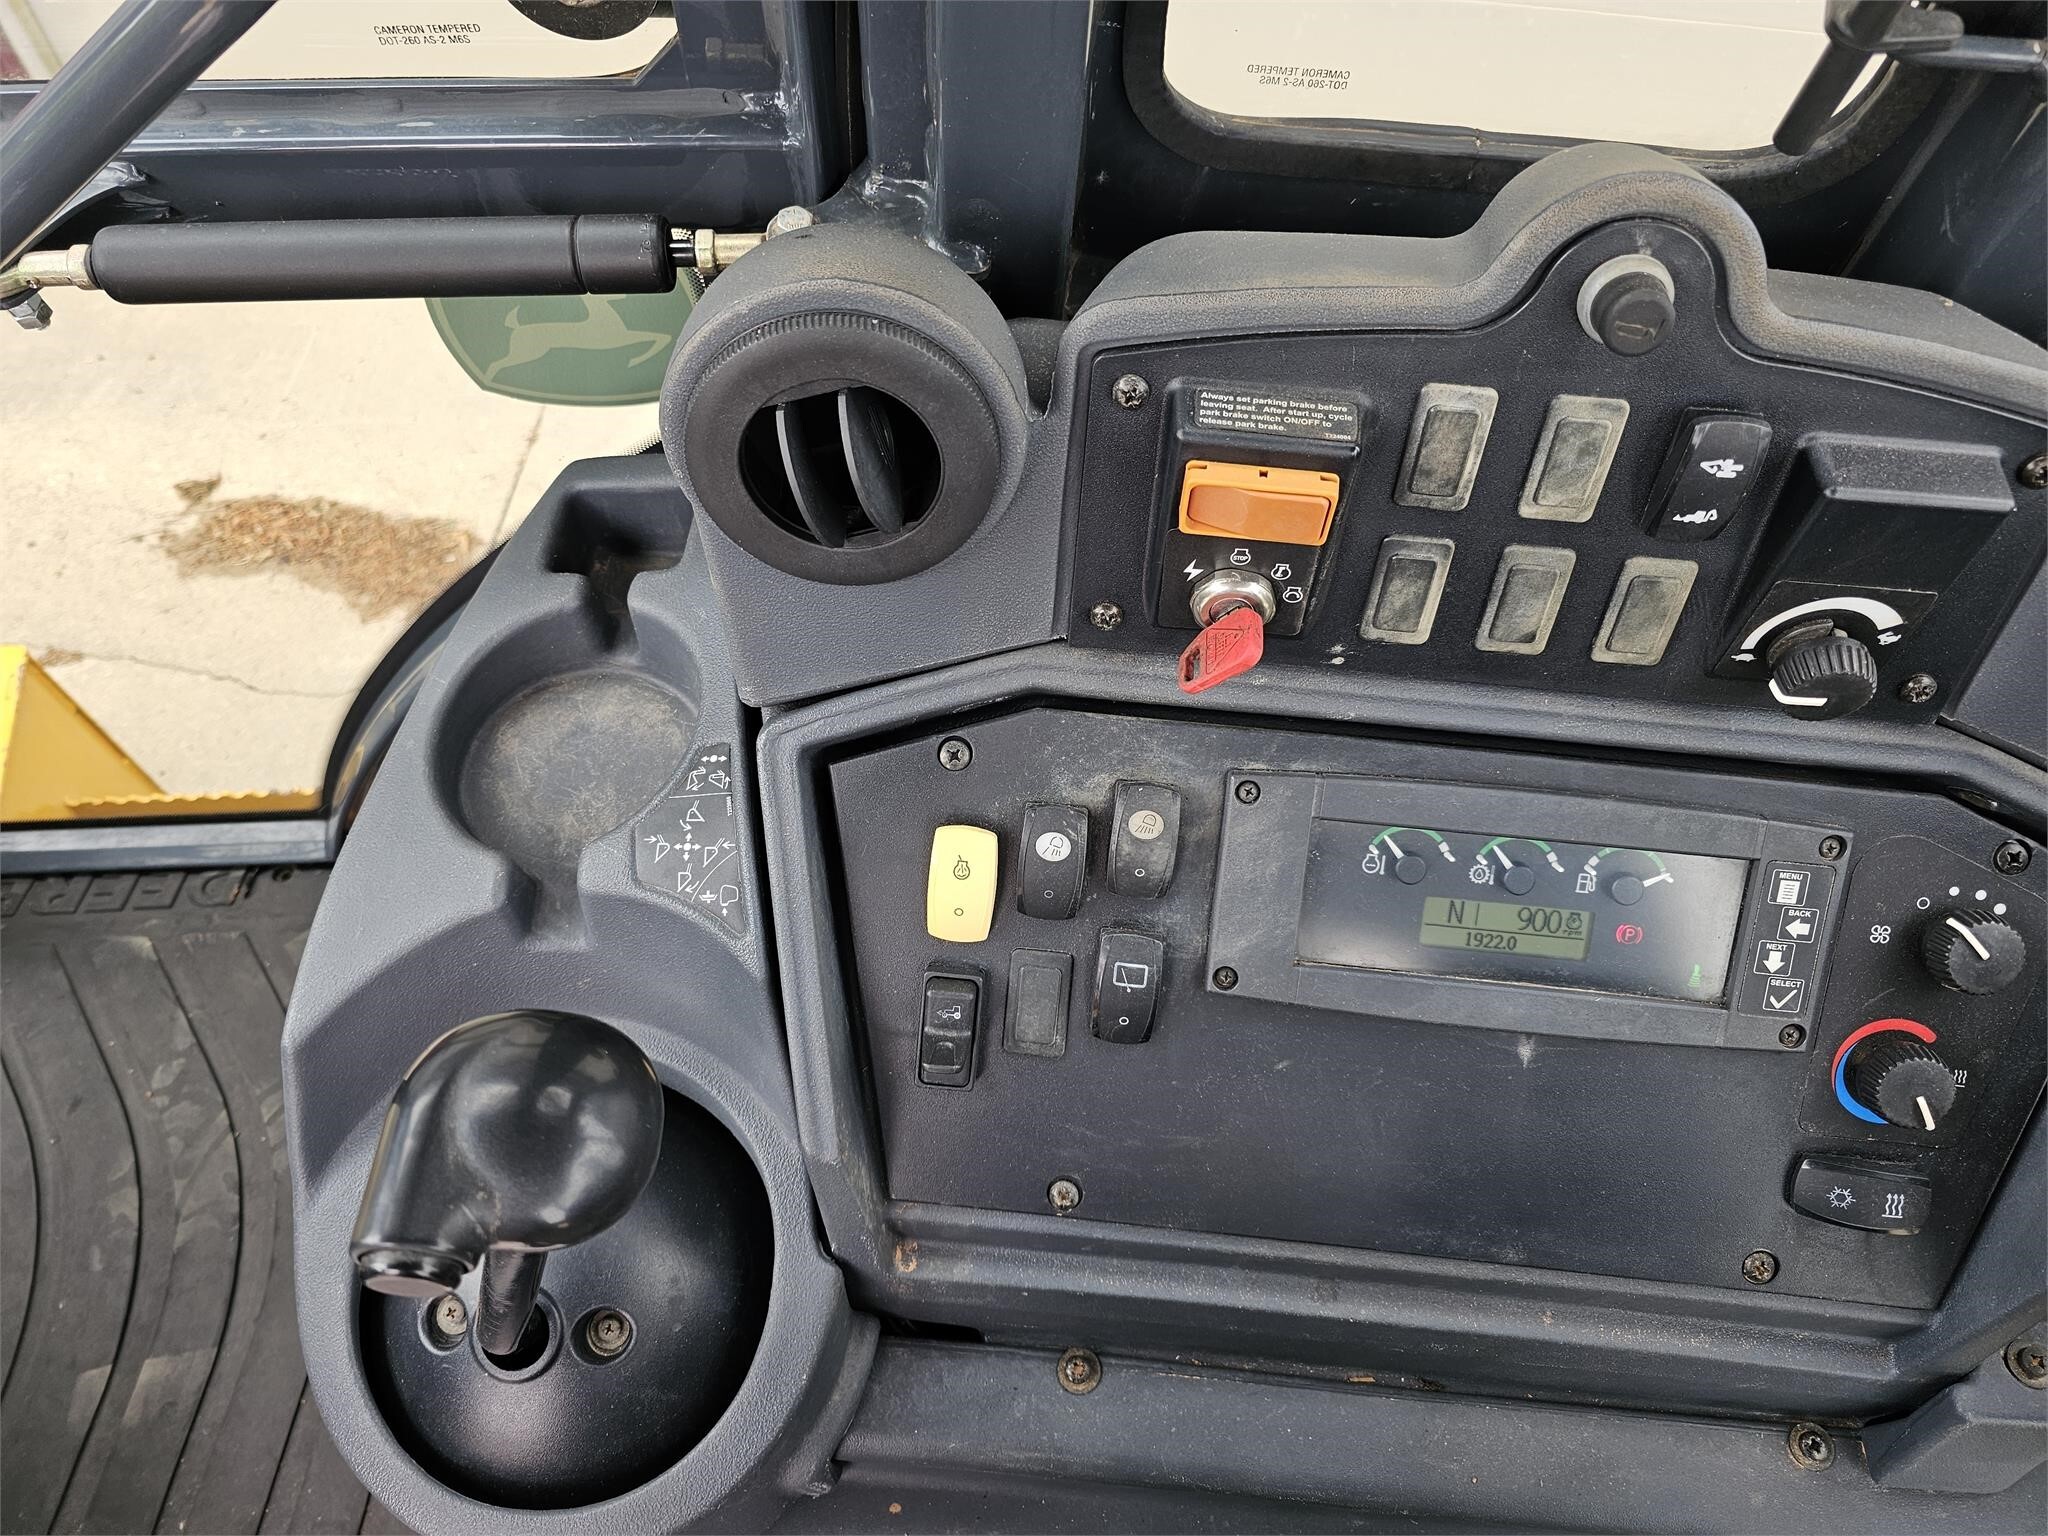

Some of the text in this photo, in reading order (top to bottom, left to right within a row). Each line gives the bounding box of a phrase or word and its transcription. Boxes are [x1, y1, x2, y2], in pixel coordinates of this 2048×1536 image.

[373, 23, 481, 35] CAMERON TEMPERED
[378, 36, 421, 46] DOT-260
[1201, 391, 1234, 402] Always
[1252, 397, 1288, 408] parking
[1289, 400, 1316, 409] brake
[1318, 403, 1348, 412] before
[1200, 399, 1353, 422] leaving seat. After start up, cycle
[1199, 417, 1287, 432] release park brake.
[1200, 409, 1332, 428] park brake switch ON/OFF to
[1779, 871, 1804, 881] MENU
[1447, 899, 1563, 934] N 900
[1788, 909, 1812, 918] BACK
[1562, 929, 1583, 937] rpm
[1465, 931, 1518, 951] 1922.0
[1766, 943, 1788, 951] NEXT
[1770, 979, 1802, 988] SELECT
